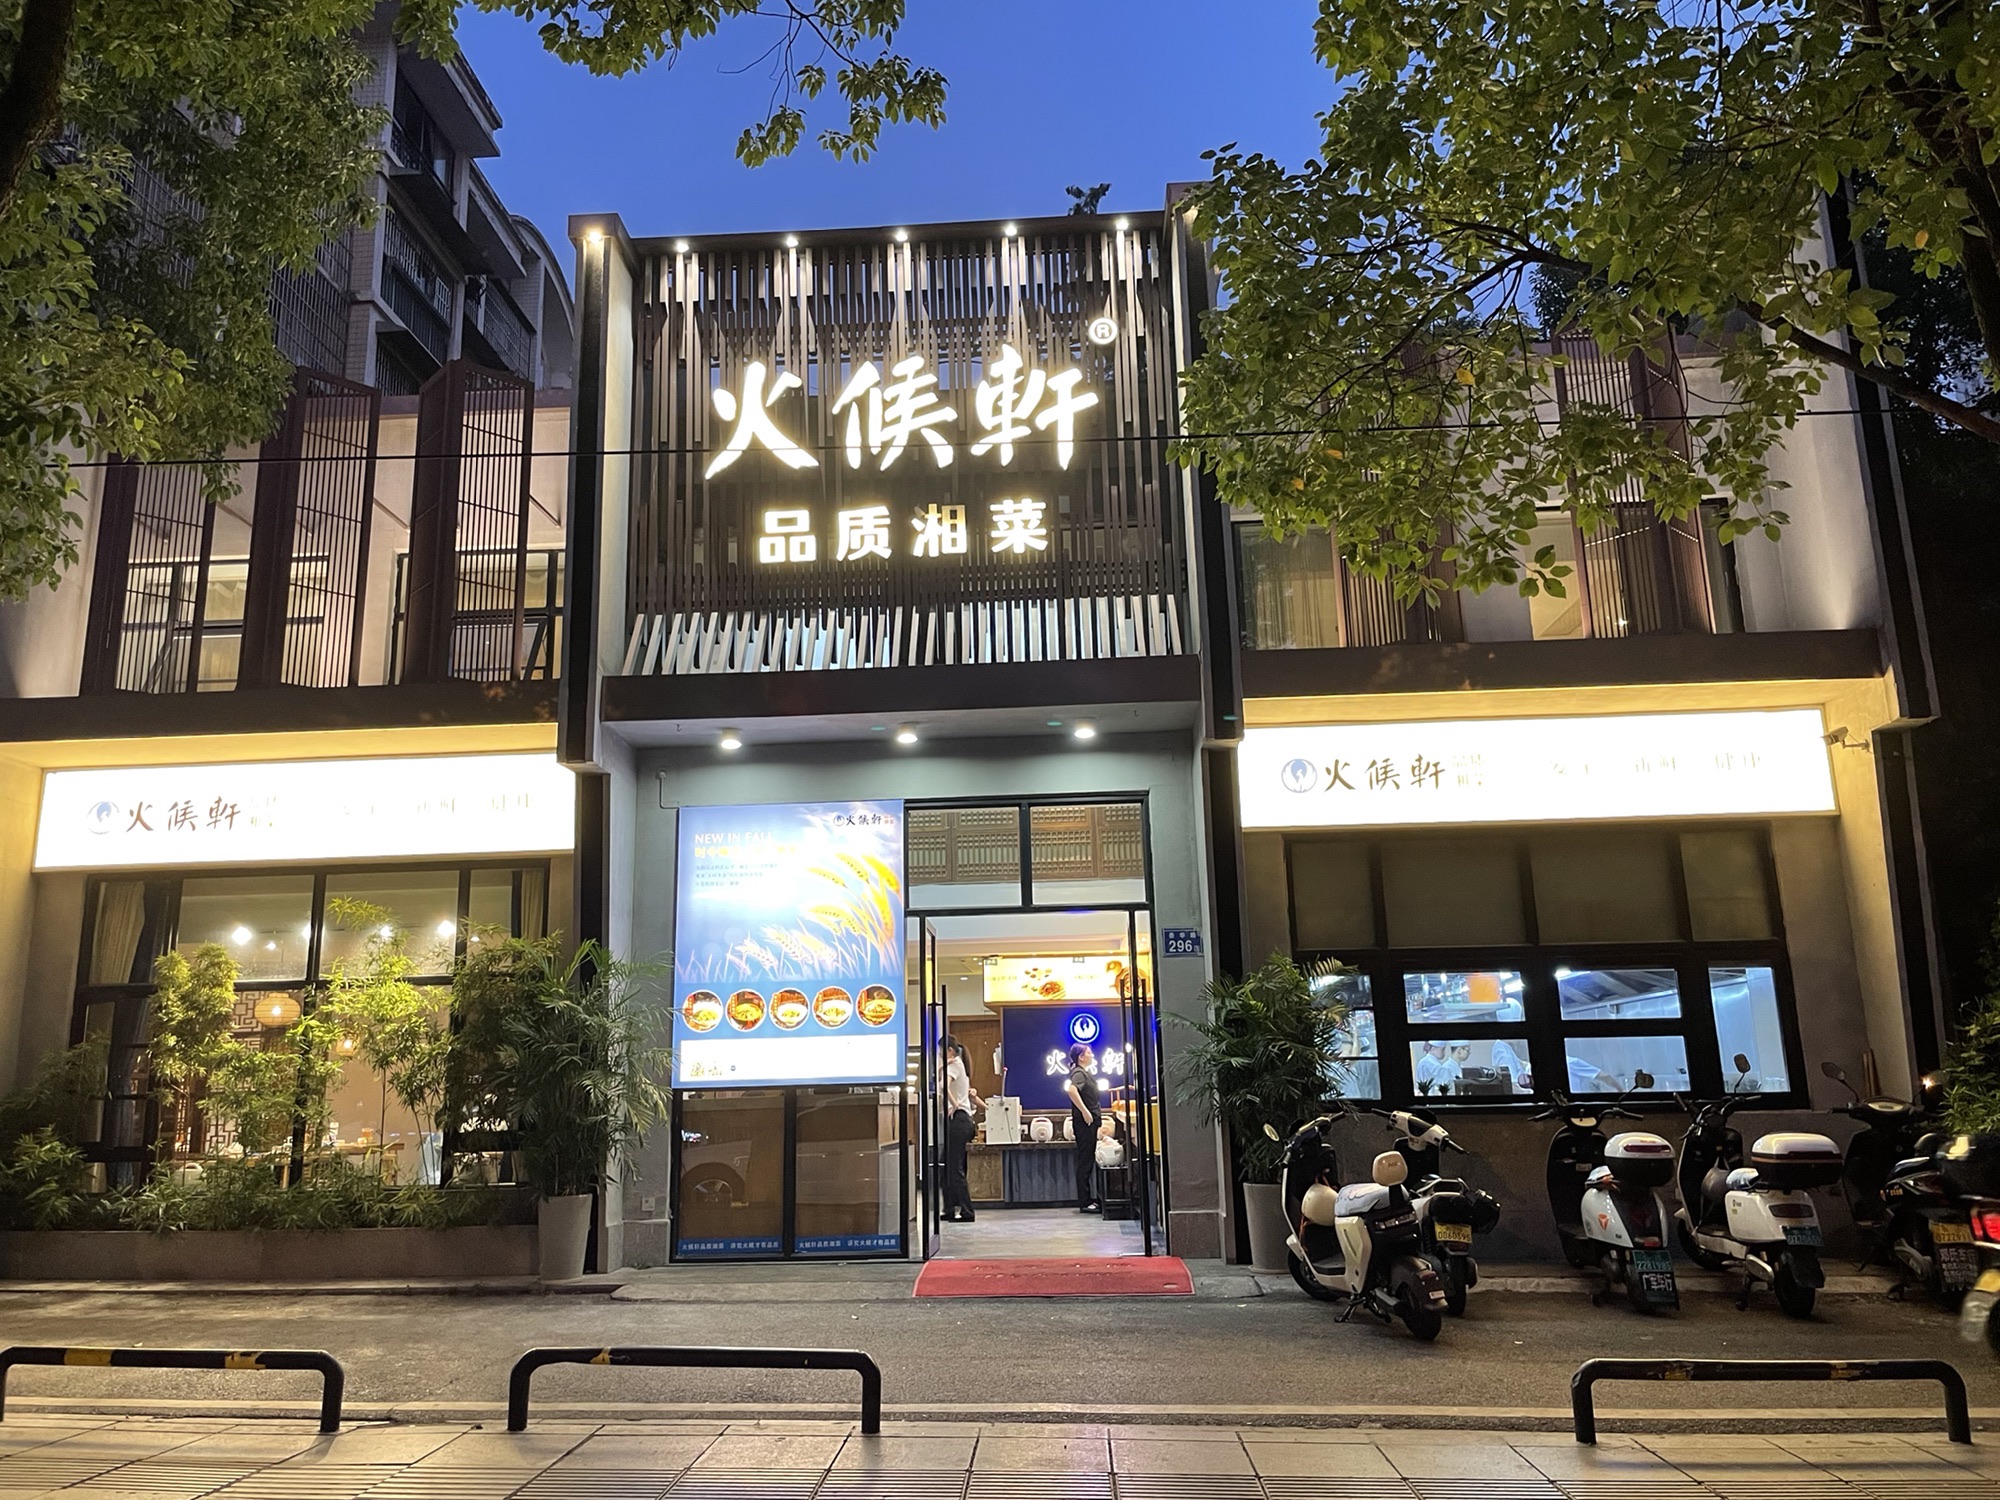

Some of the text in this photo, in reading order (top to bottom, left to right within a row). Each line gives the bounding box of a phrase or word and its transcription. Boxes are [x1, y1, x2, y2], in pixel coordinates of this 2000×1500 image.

[704, 344, 1100, 480] 火候軒
[757, 497, 1050, 565] 品质湘菜
[1323, 753, 1447, 793] 火候軒
[124, 795, 242, 833] 火候軒
[694, 833, 724, 844] NEW
[727, 832, 741, 843] IN
[1168, 939, 1193, 953] 296
[1046, 1048, 1125, 1076] 火軒
